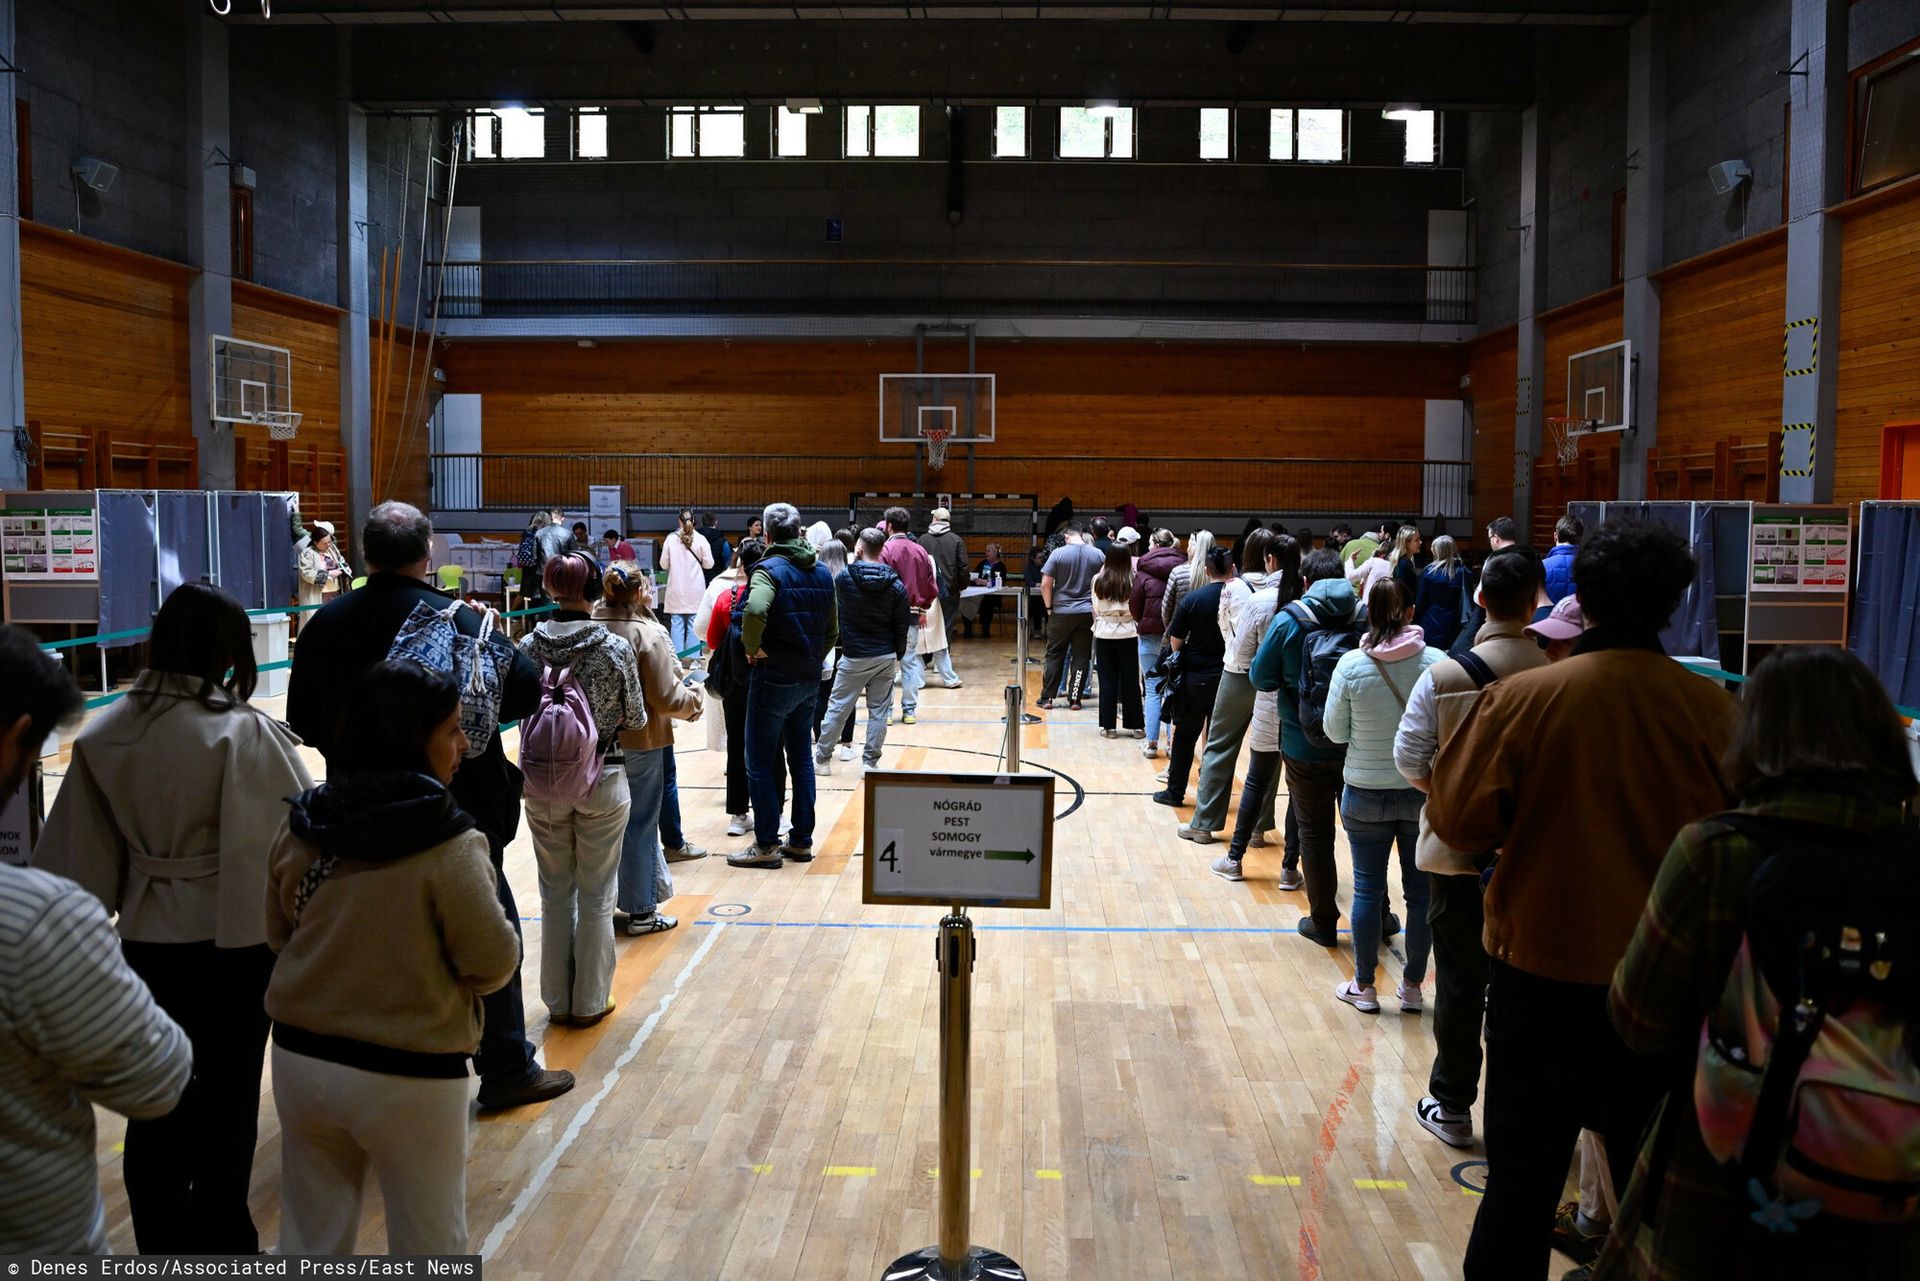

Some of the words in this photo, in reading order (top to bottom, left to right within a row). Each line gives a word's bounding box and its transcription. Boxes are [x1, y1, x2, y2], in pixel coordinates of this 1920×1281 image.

[932, 798, 983, 813] NÓGRÁD
[943, 816, 971, 828] PEST
[931, 831, 982, 843] SOMOGY
[878, 840, 902, 874] 4.
[929, 847, 983, 861] vármegye
